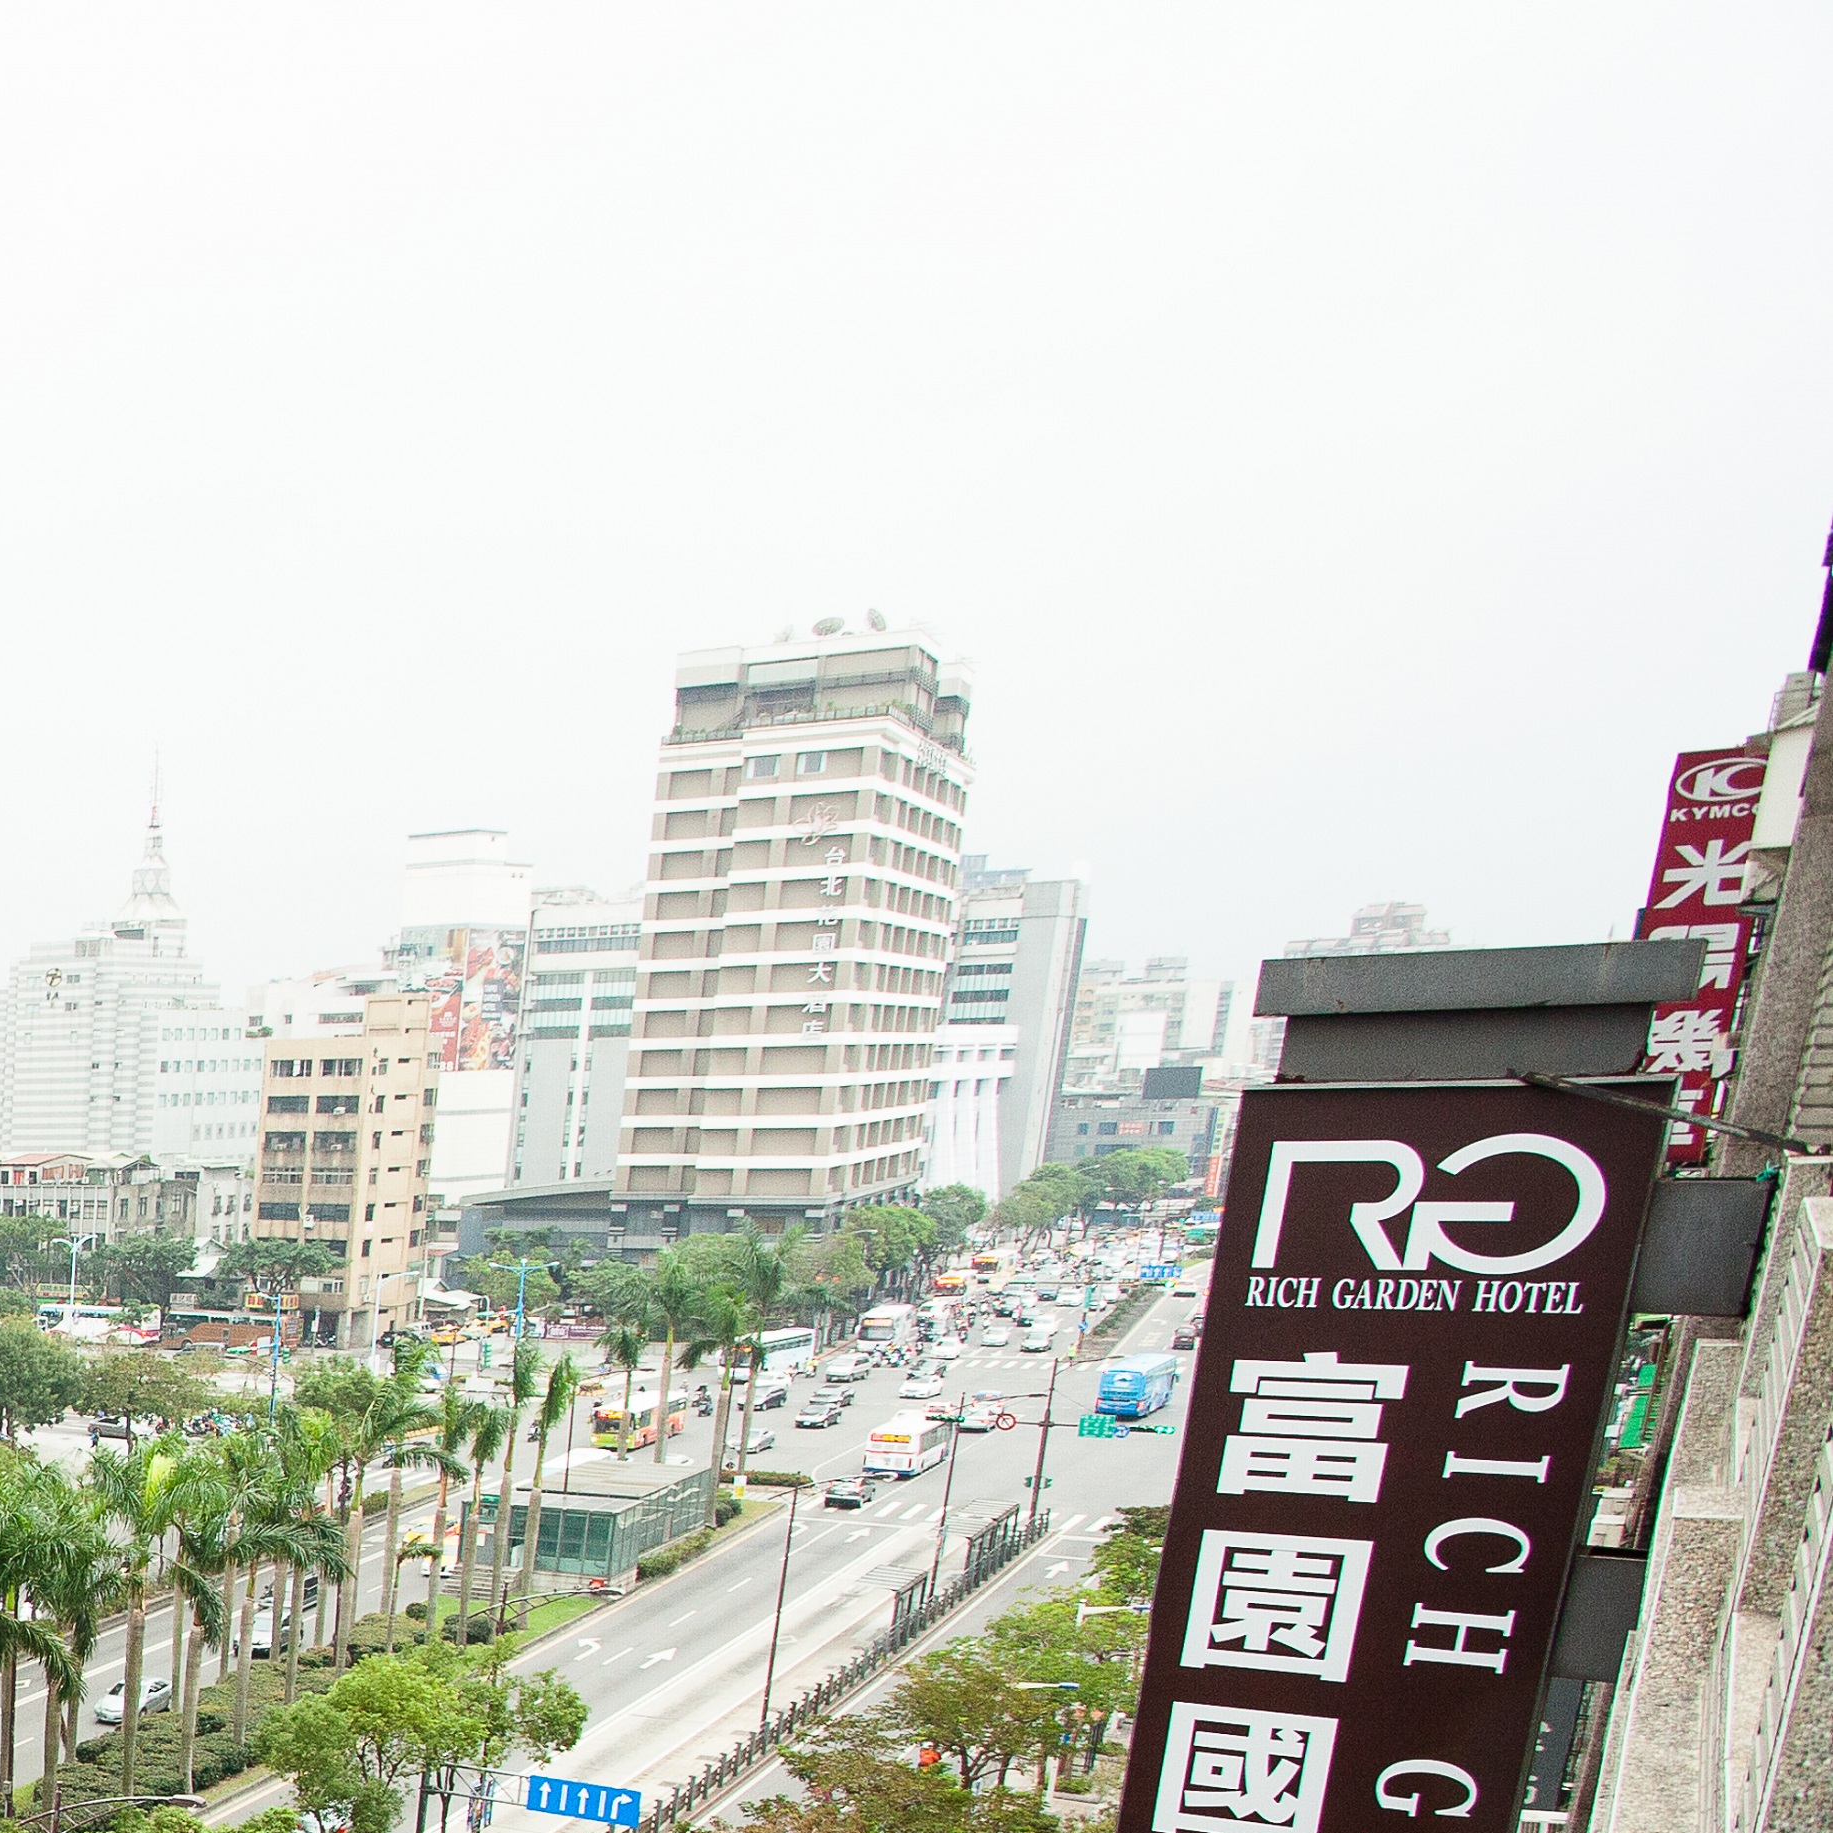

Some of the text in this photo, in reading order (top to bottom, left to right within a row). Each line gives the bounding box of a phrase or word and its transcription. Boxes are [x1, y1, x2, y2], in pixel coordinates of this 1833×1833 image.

[1245, 1277, 1584, 1314] RICH GARDEN HOTEL
[1404, 1361, 1571, 1675] RICH
